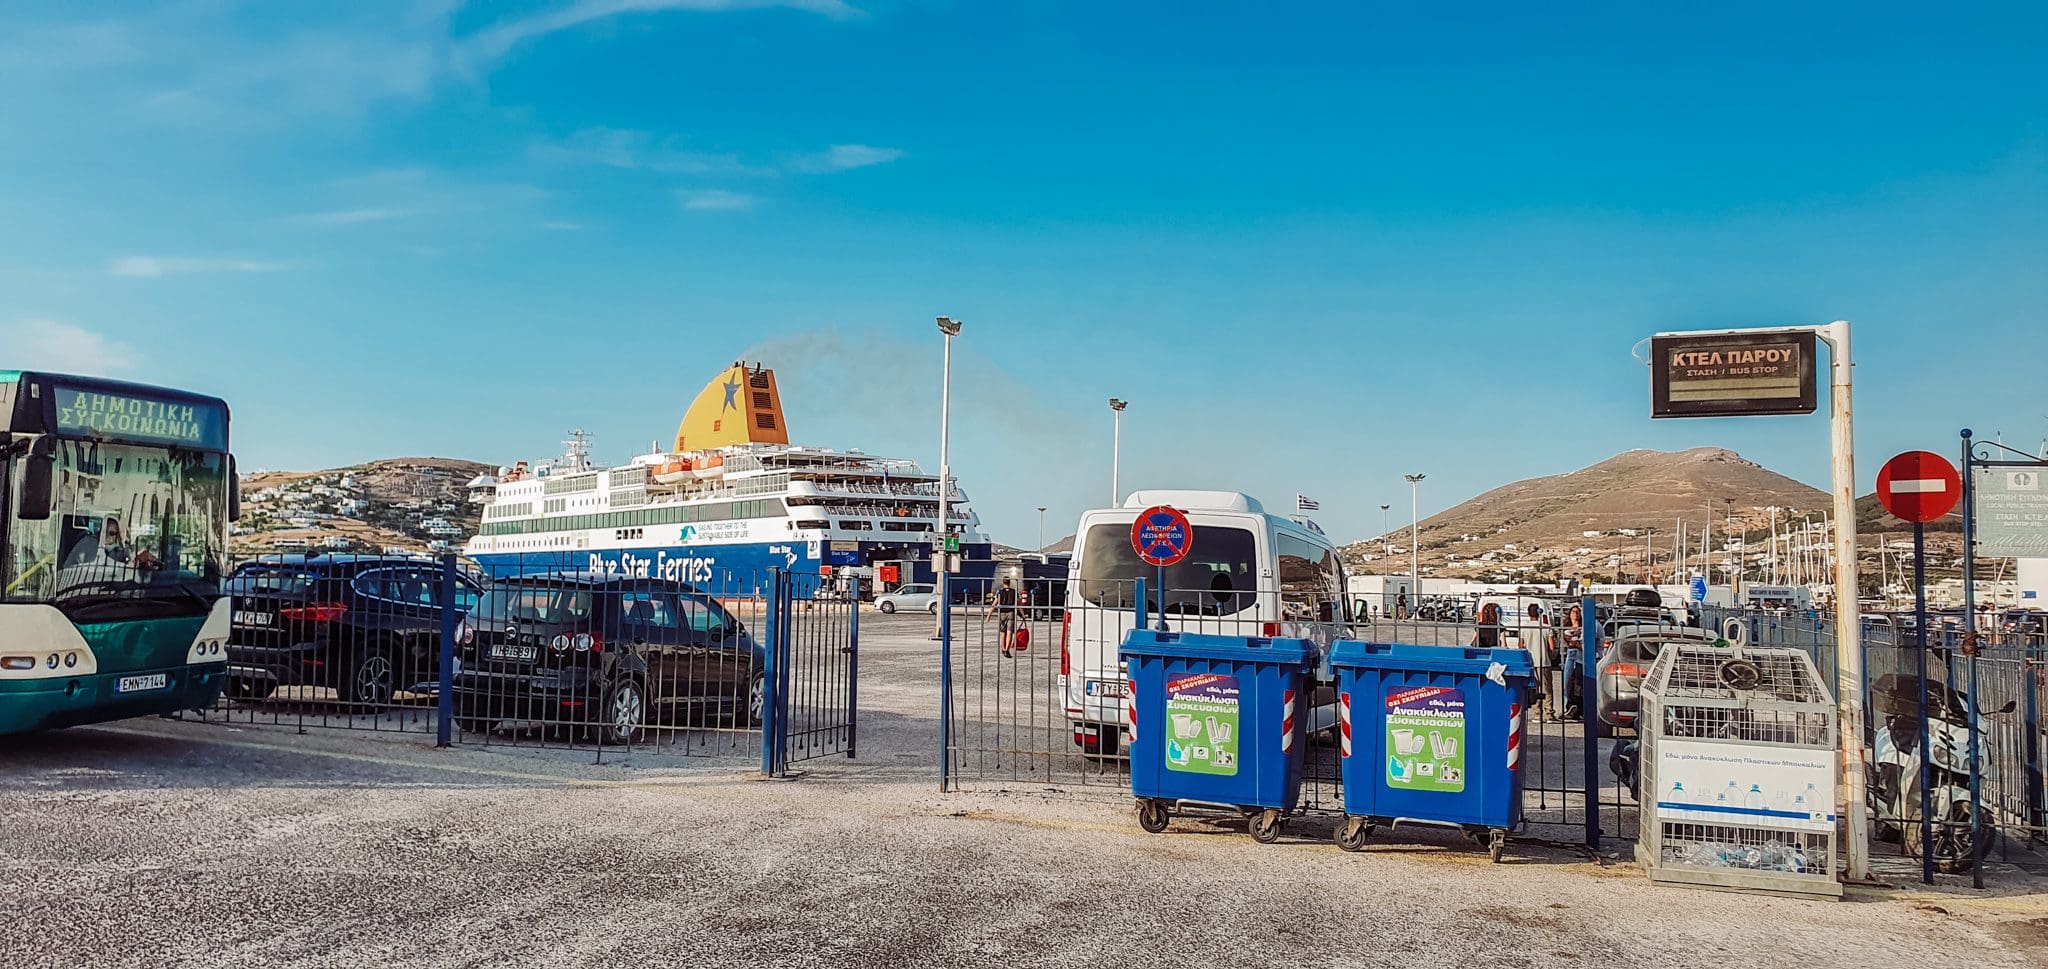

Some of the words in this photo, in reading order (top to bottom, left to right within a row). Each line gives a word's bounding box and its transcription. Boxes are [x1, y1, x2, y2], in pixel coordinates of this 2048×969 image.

[1672, 352, 1722, 367] ΚΤΕΛ
[1727, 349, 1792, 364] ΠΑΡΟΥ
[1687, 368, 1717, 377] ΣΤΑΣΗ
[1730, 367, 1750, 375] BUS
[1752, 366, 1778, 374] STOP
[74, 392, 193, 422] ΔΗΜΟΤΙΚΗ
[60, 408, 200, 438] ΣΥΓΚΟΙΝΩΝΙΑ
[589, 552, 618, 574] Blue
[621, 552, 650, 576] Star
[658, 550, 712, 583] Ferries
[1173, 692, 1239, 705] Ανακύκλωση
[1167, 699, 1239, 714] Συσκευασιών
[1393, 706, 1464, 719] Ανακύκλωση
[1386, 714, 1465, 728] Συσκευασιών
